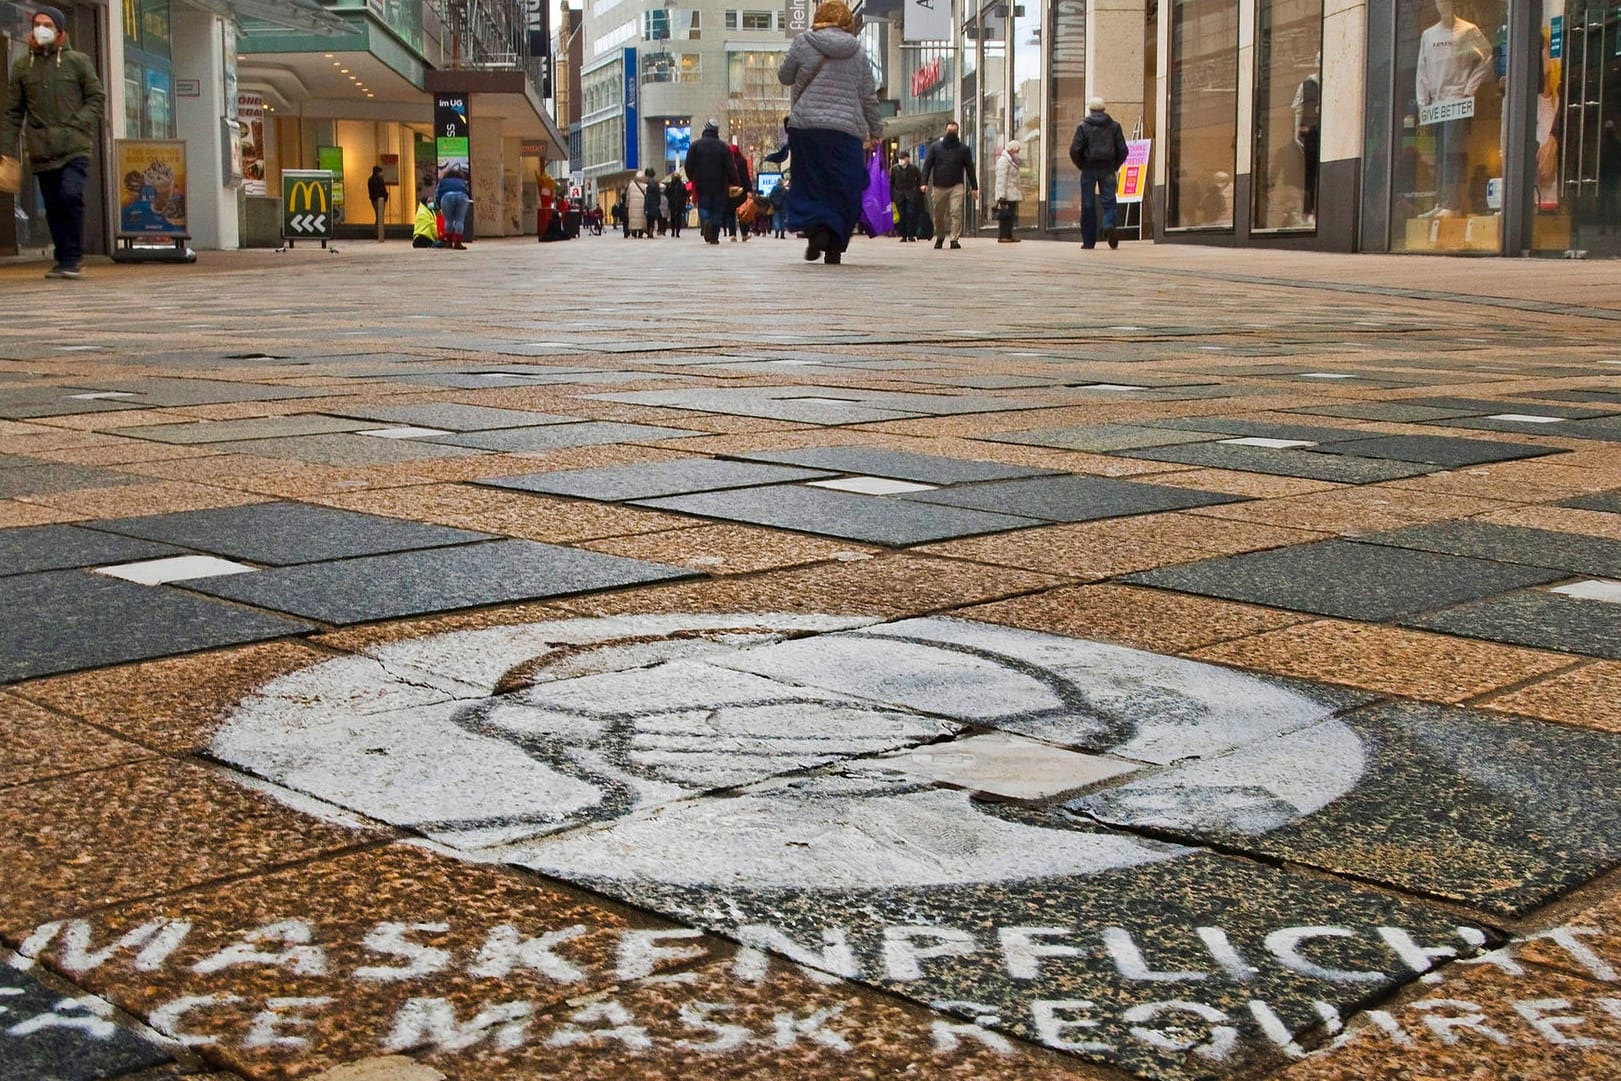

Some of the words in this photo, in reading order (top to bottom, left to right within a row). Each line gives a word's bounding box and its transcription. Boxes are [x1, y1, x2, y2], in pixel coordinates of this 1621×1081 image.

[450, 98, 463, 107] UG
[1421, 106, 1439, 122] GIVE
[1440, 100, 1473, 118] BETTER
[9, 916, 1621, 984] MASKENPFLICHT
[0, 986, 337, 1051] ACE
[381, 995, 854, 1055] MASK
